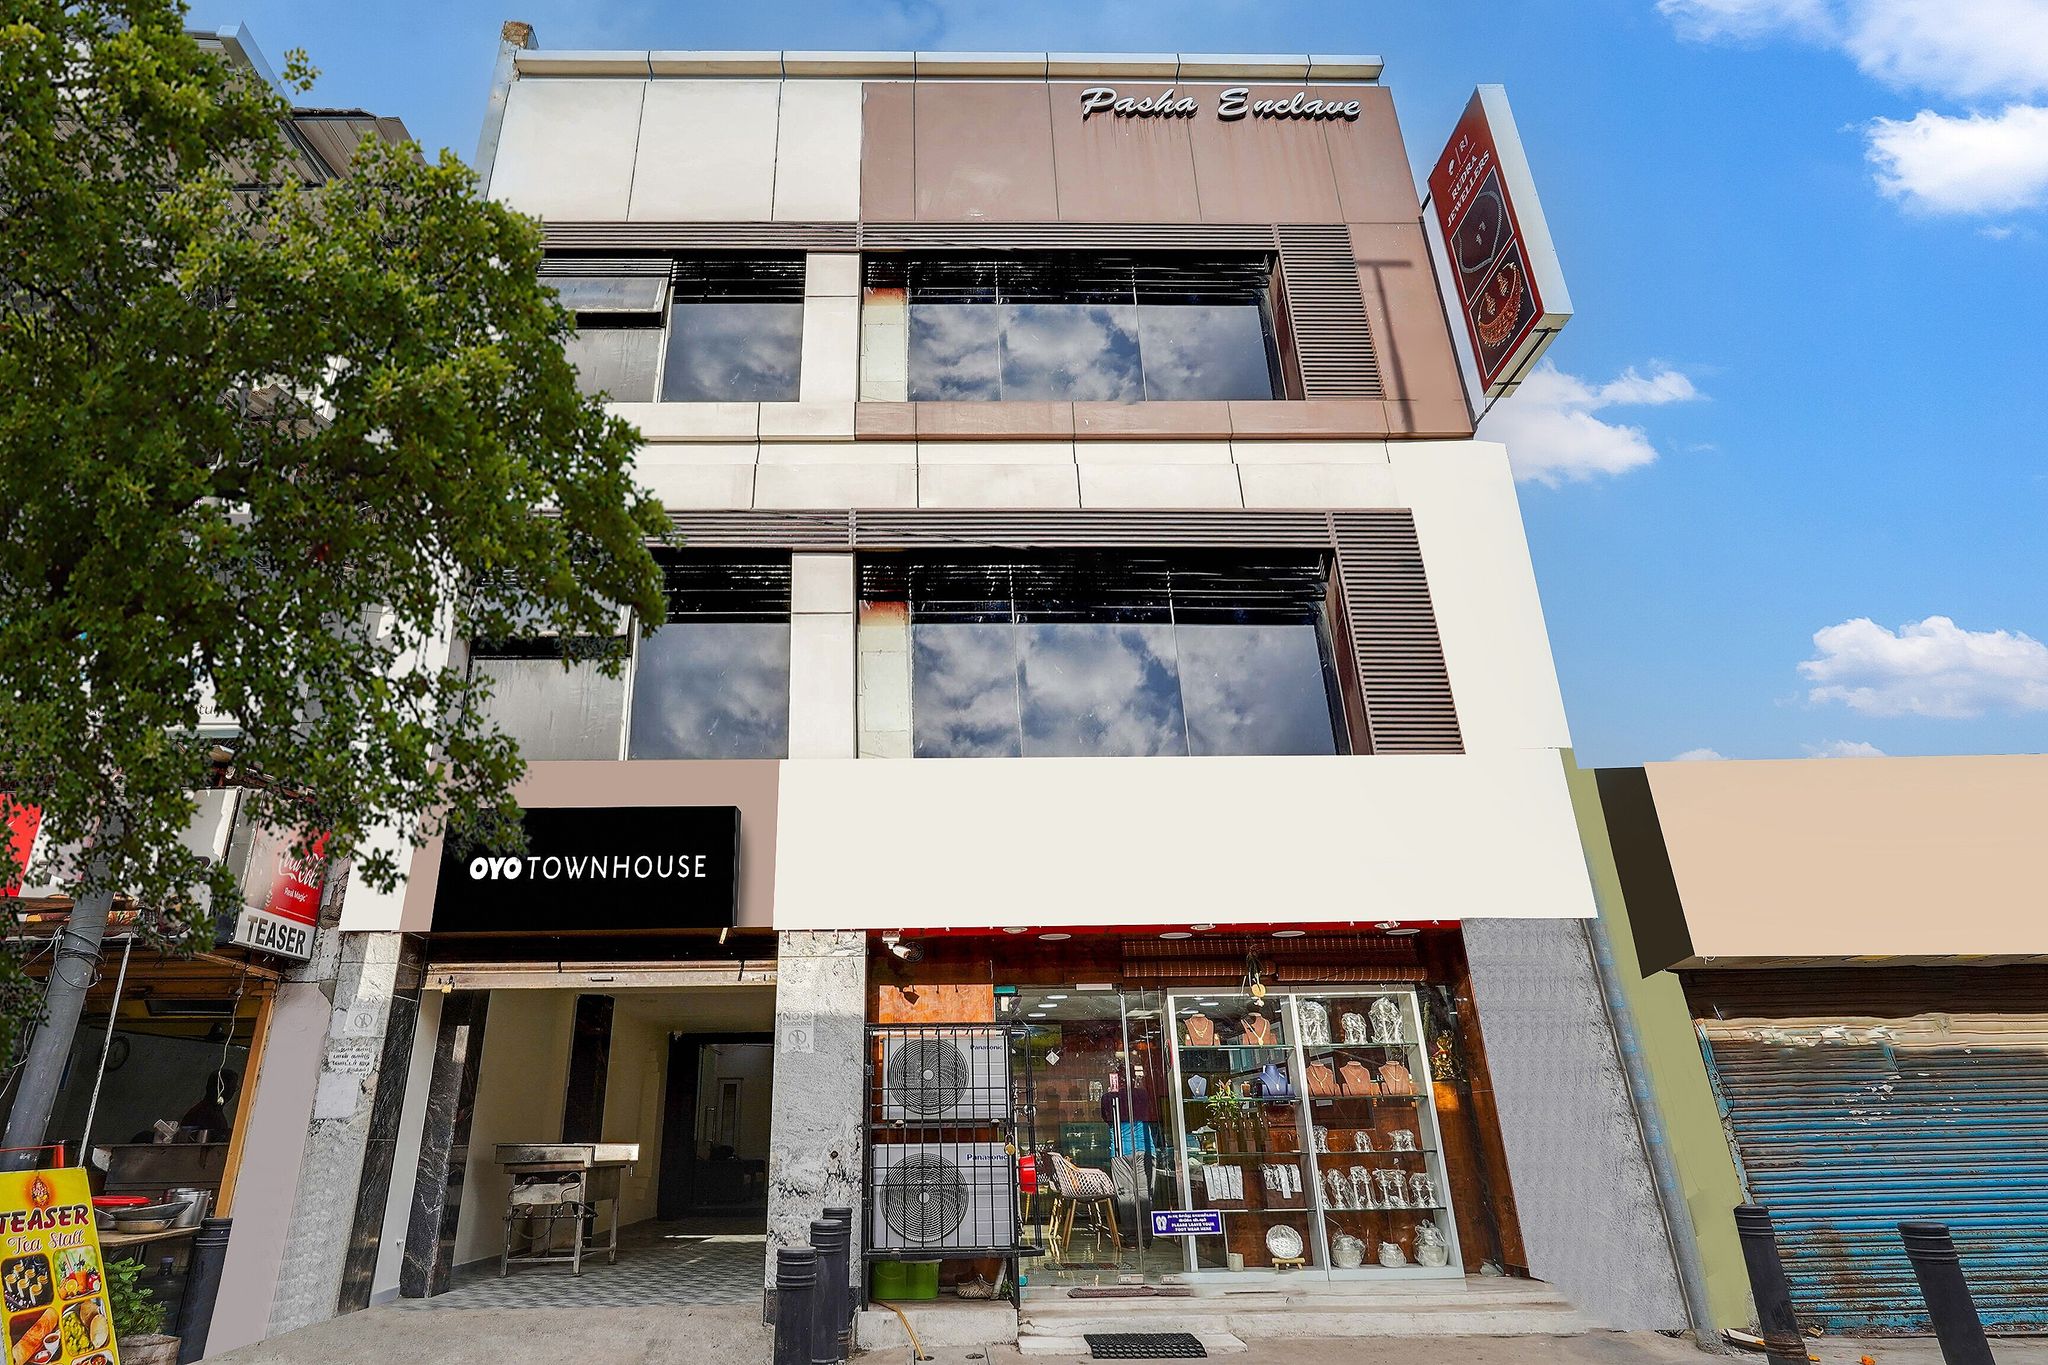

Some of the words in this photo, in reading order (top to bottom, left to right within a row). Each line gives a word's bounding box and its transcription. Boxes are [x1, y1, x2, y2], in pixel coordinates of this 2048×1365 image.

[1080, 87, 1199, 120] Pasha
[1217, 87, 1361, 121] Enclave
[1447, 149, 1490, 228] JEWELLERS
[1451, 155, 1478, 201] RUDRA
[469, 856, 522, 880] OYO
[526, 855, 707, 880] TOWNHOUSE
[246, 914, 306, 956] TEASER
[0, 1204, 89, 1234] TEASER
[7, 1236, 42, 1255] Tea
[48, 1229, 85, 1249] Stall
